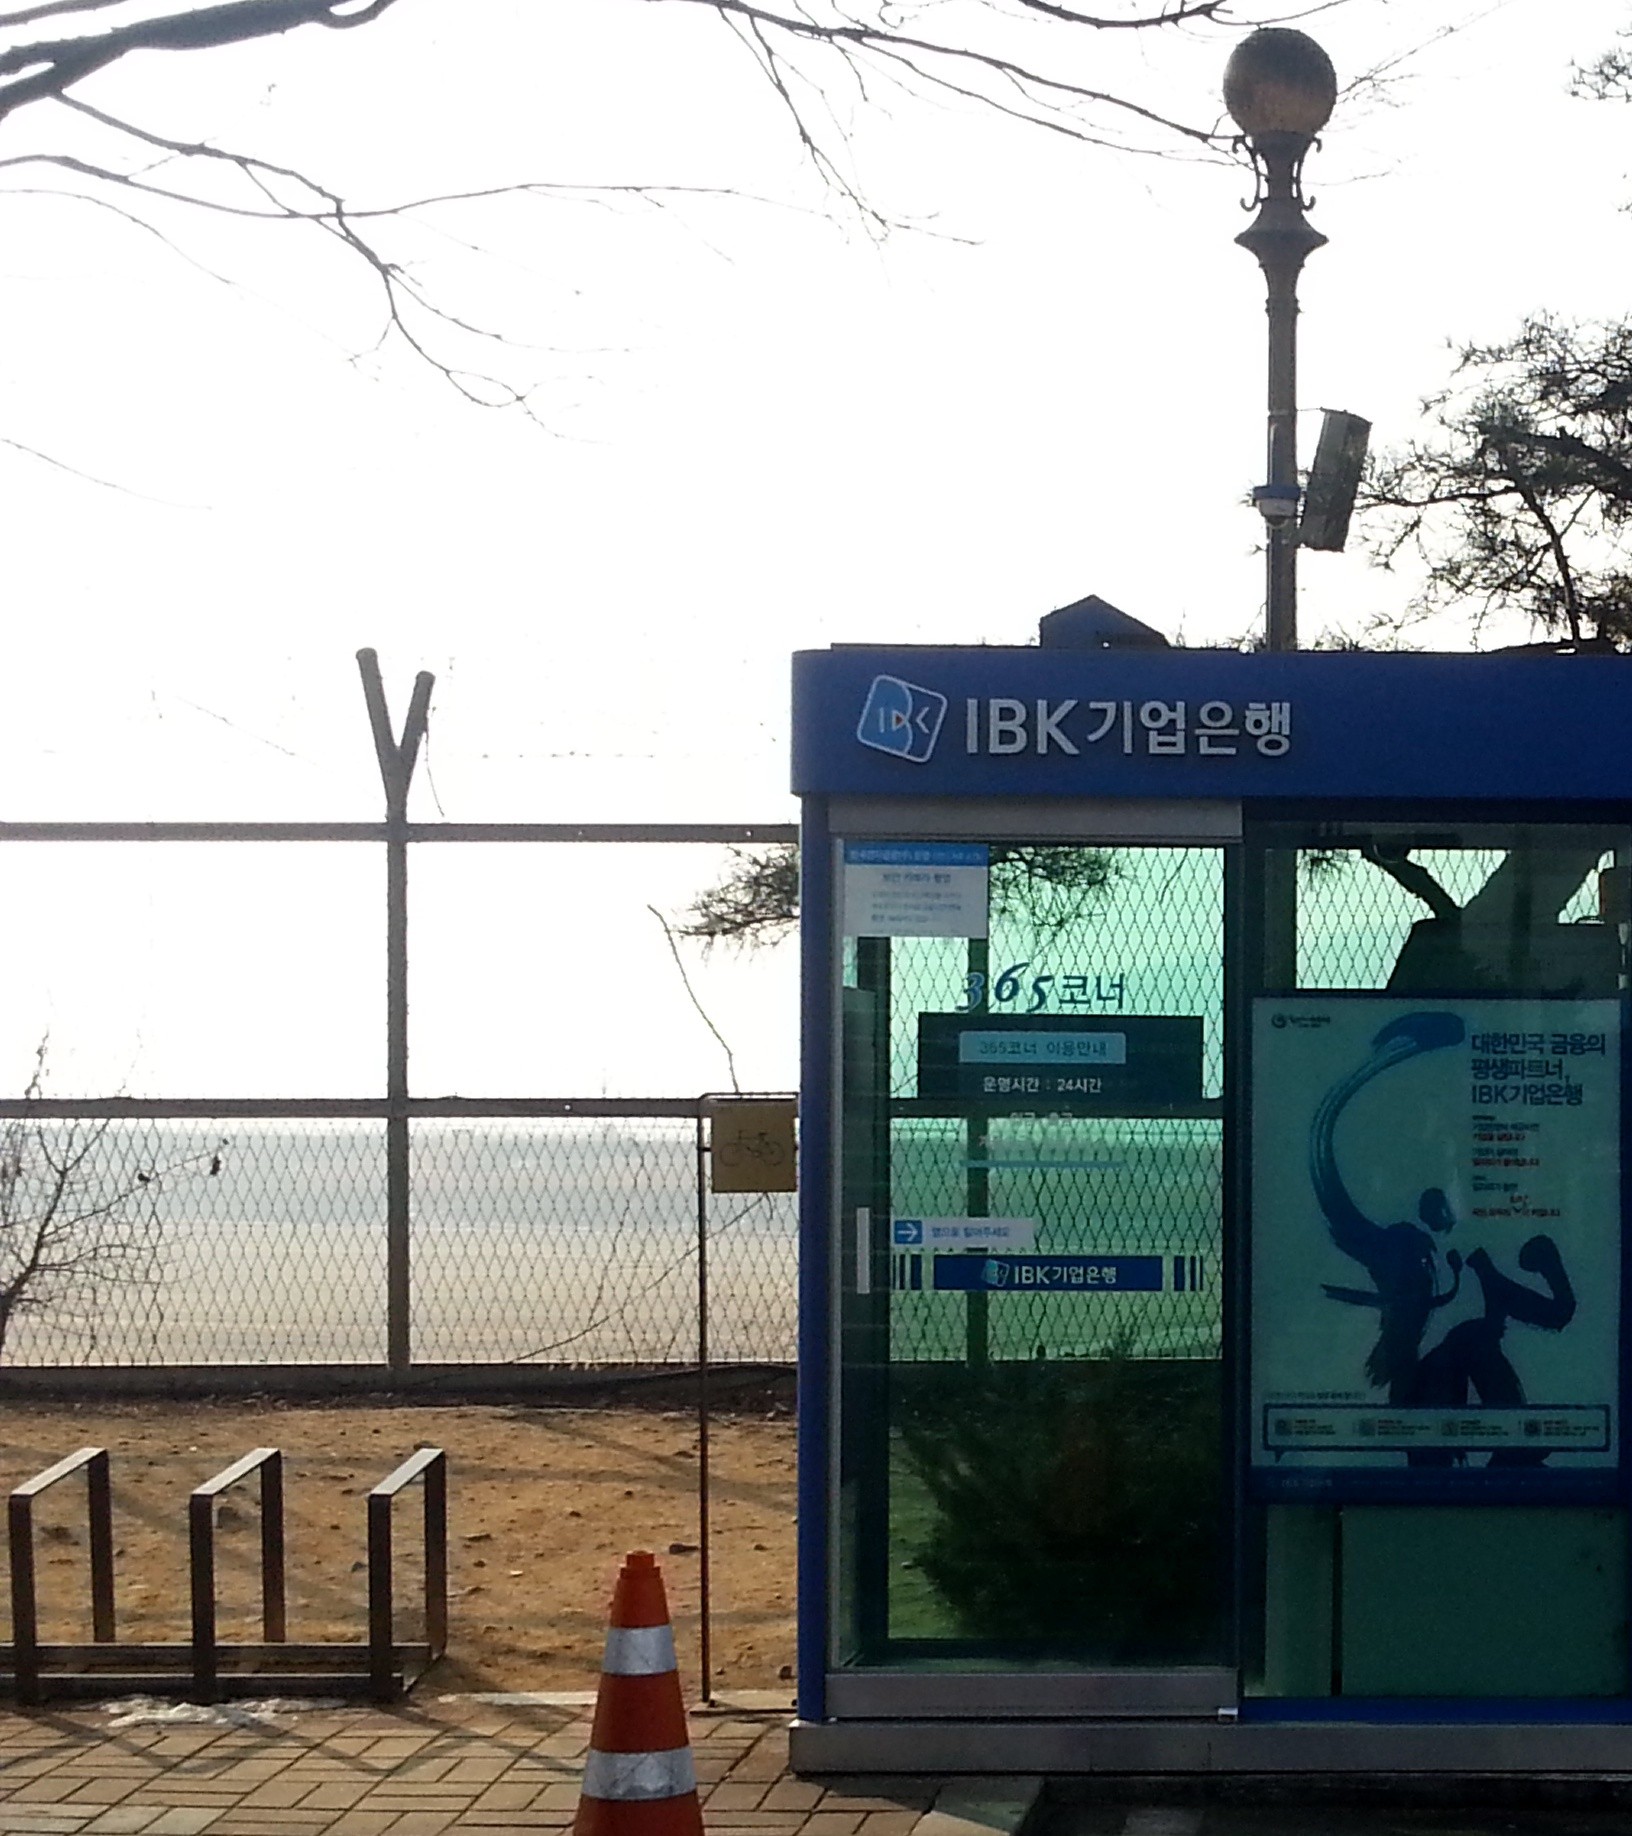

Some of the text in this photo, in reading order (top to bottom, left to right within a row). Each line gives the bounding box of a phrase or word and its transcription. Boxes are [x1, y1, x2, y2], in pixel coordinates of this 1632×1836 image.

[966, 697, 1292, 758] IBK기업은행
[954, 961, 1126, 1014] 365코너
[979, 1040, 1108, 1057] 365코너 이용안내
[1471, 1033, 1606, 1056] 대한민국 금융의
[1471, 1058, 1571, 1083] 평생파트너,
[983, 1075, 1040, 1093] 운영시간
[1056, 1076, 1103, 1094] 24시간
[1471, 1083, 1584, 1106] IBK기업은행
[1013, 1266, 1118, 1286] IBK기업은행
